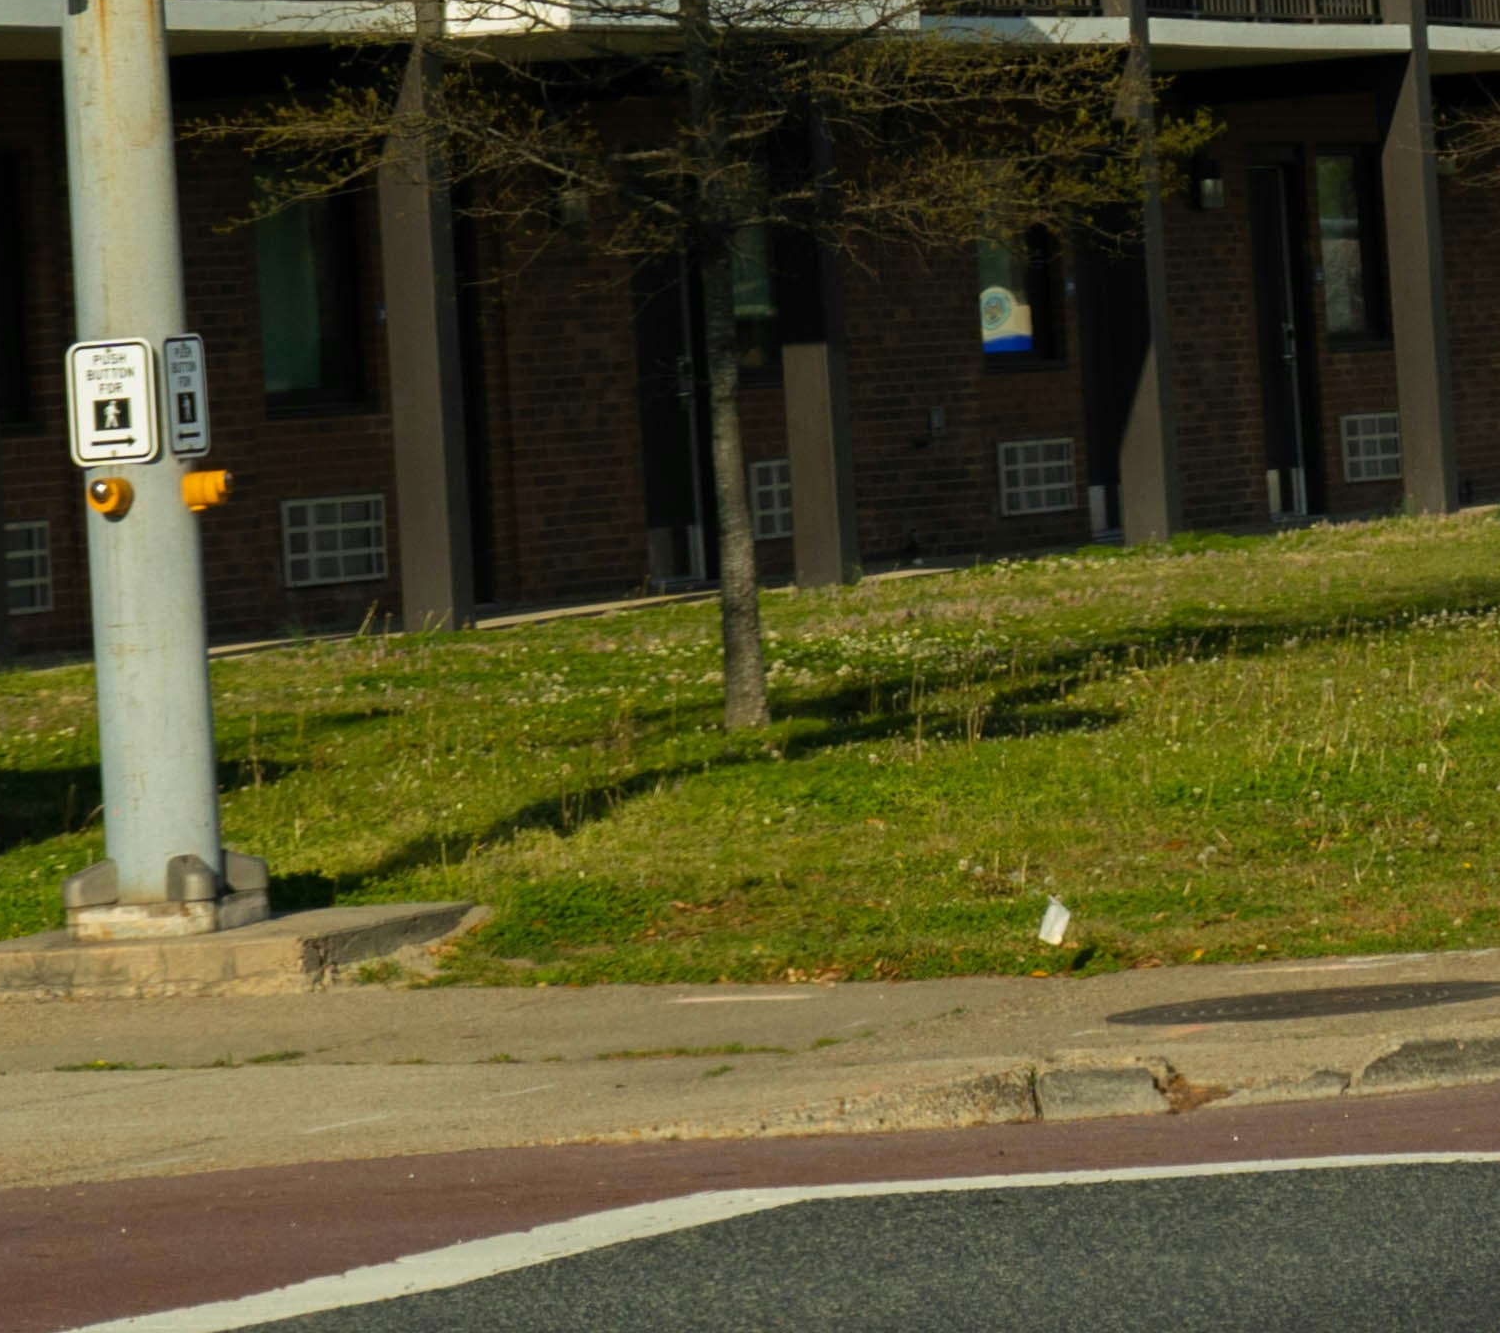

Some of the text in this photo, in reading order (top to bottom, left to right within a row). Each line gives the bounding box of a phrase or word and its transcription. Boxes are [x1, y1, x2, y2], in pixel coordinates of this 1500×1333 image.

[92, 353, 127, 365] PUSH
[86, 367, 135, 381] BUTTON
[99, 382, 123, 394] FOR
